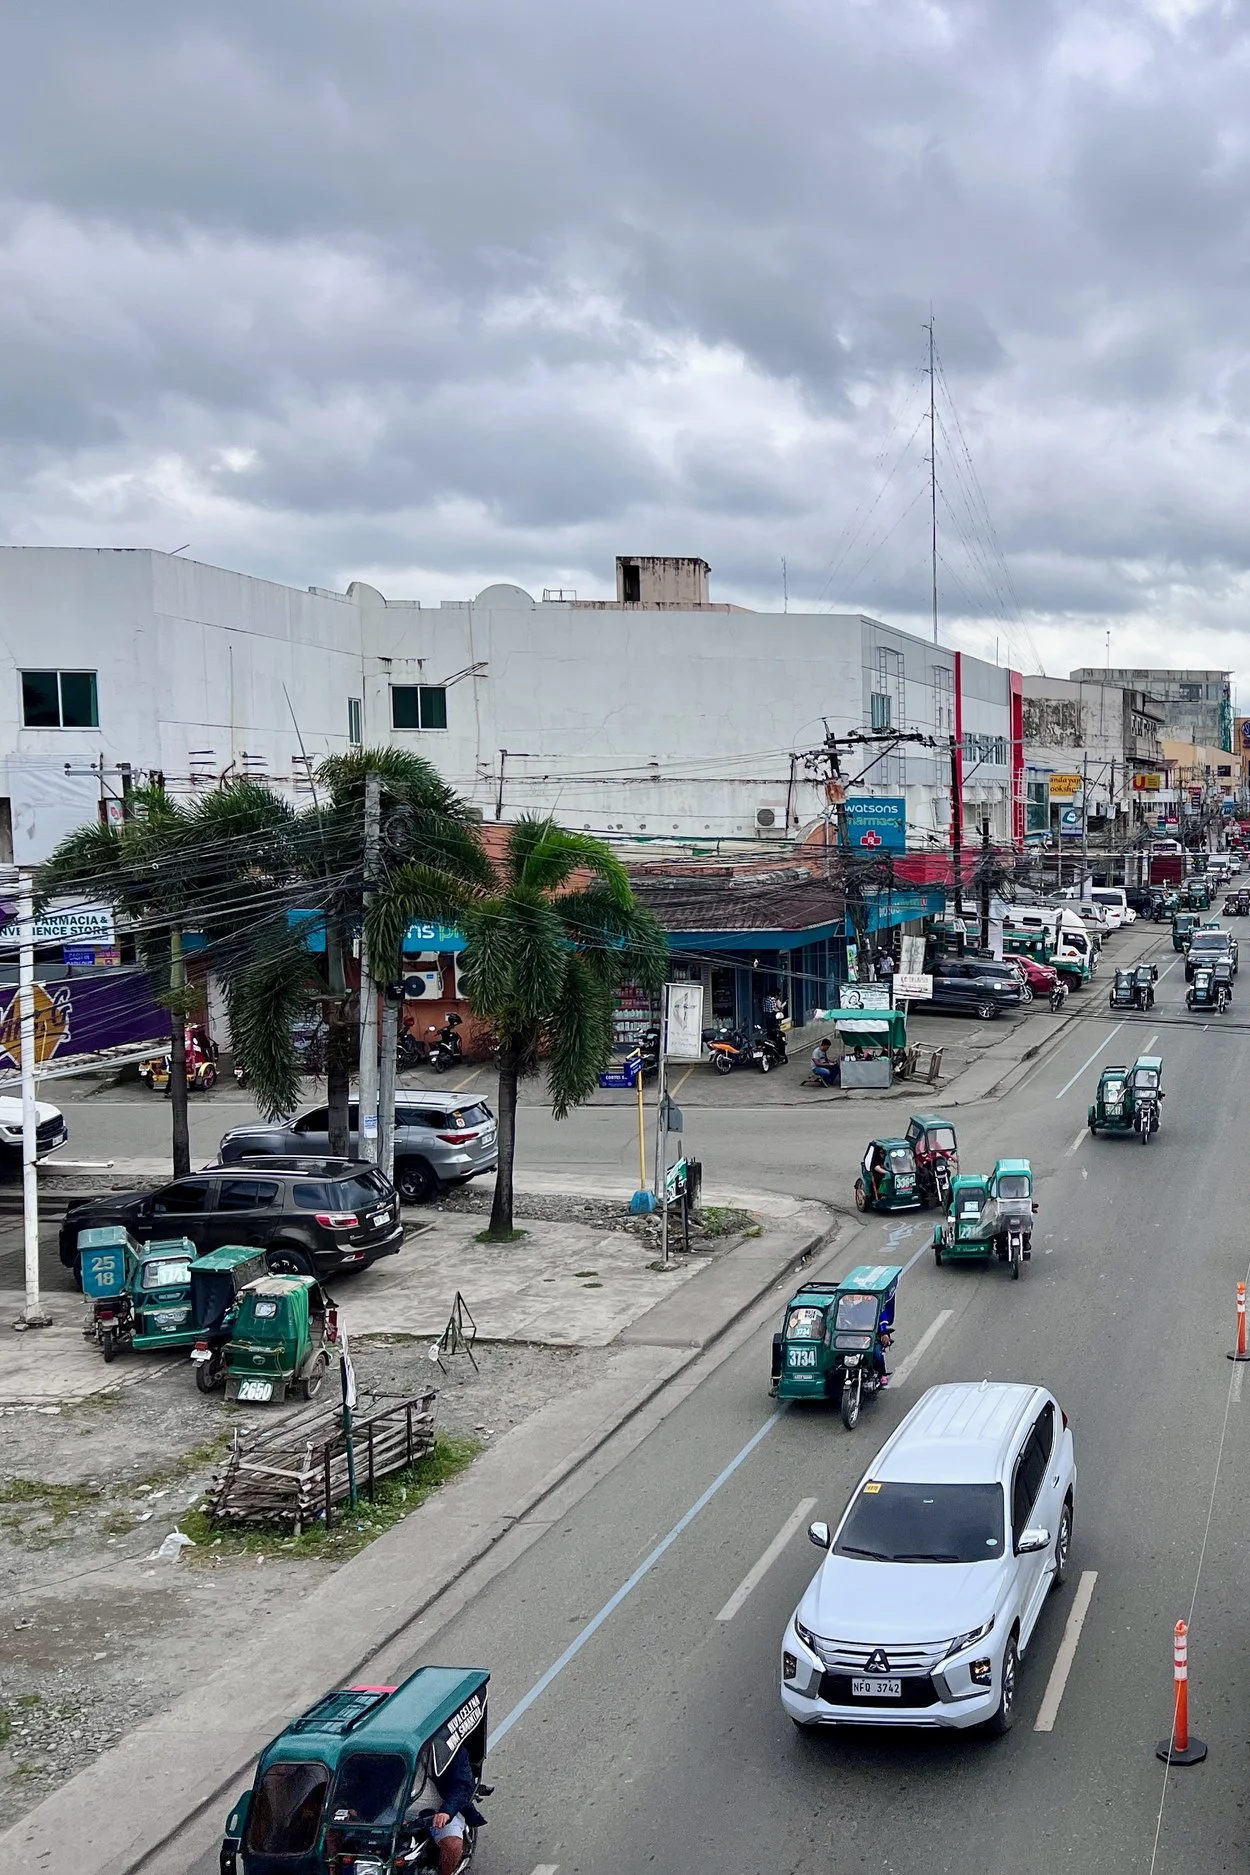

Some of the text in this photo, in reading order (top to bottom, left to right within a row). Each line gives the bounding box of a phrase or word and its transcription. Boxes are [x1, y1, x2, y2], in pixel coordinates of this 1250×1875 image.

[845, 804, 898, 813] watsons
[34, 915, 108, 926] FARMACIA &
[91, 1256, 116, 1272] 25
[93, 1272, 116, 1287] 18
[789, 1350, 816, 1366] 3734
[238, 1381, 273, 1400] 2650
[876, 1683, 900, 1694] 3742
